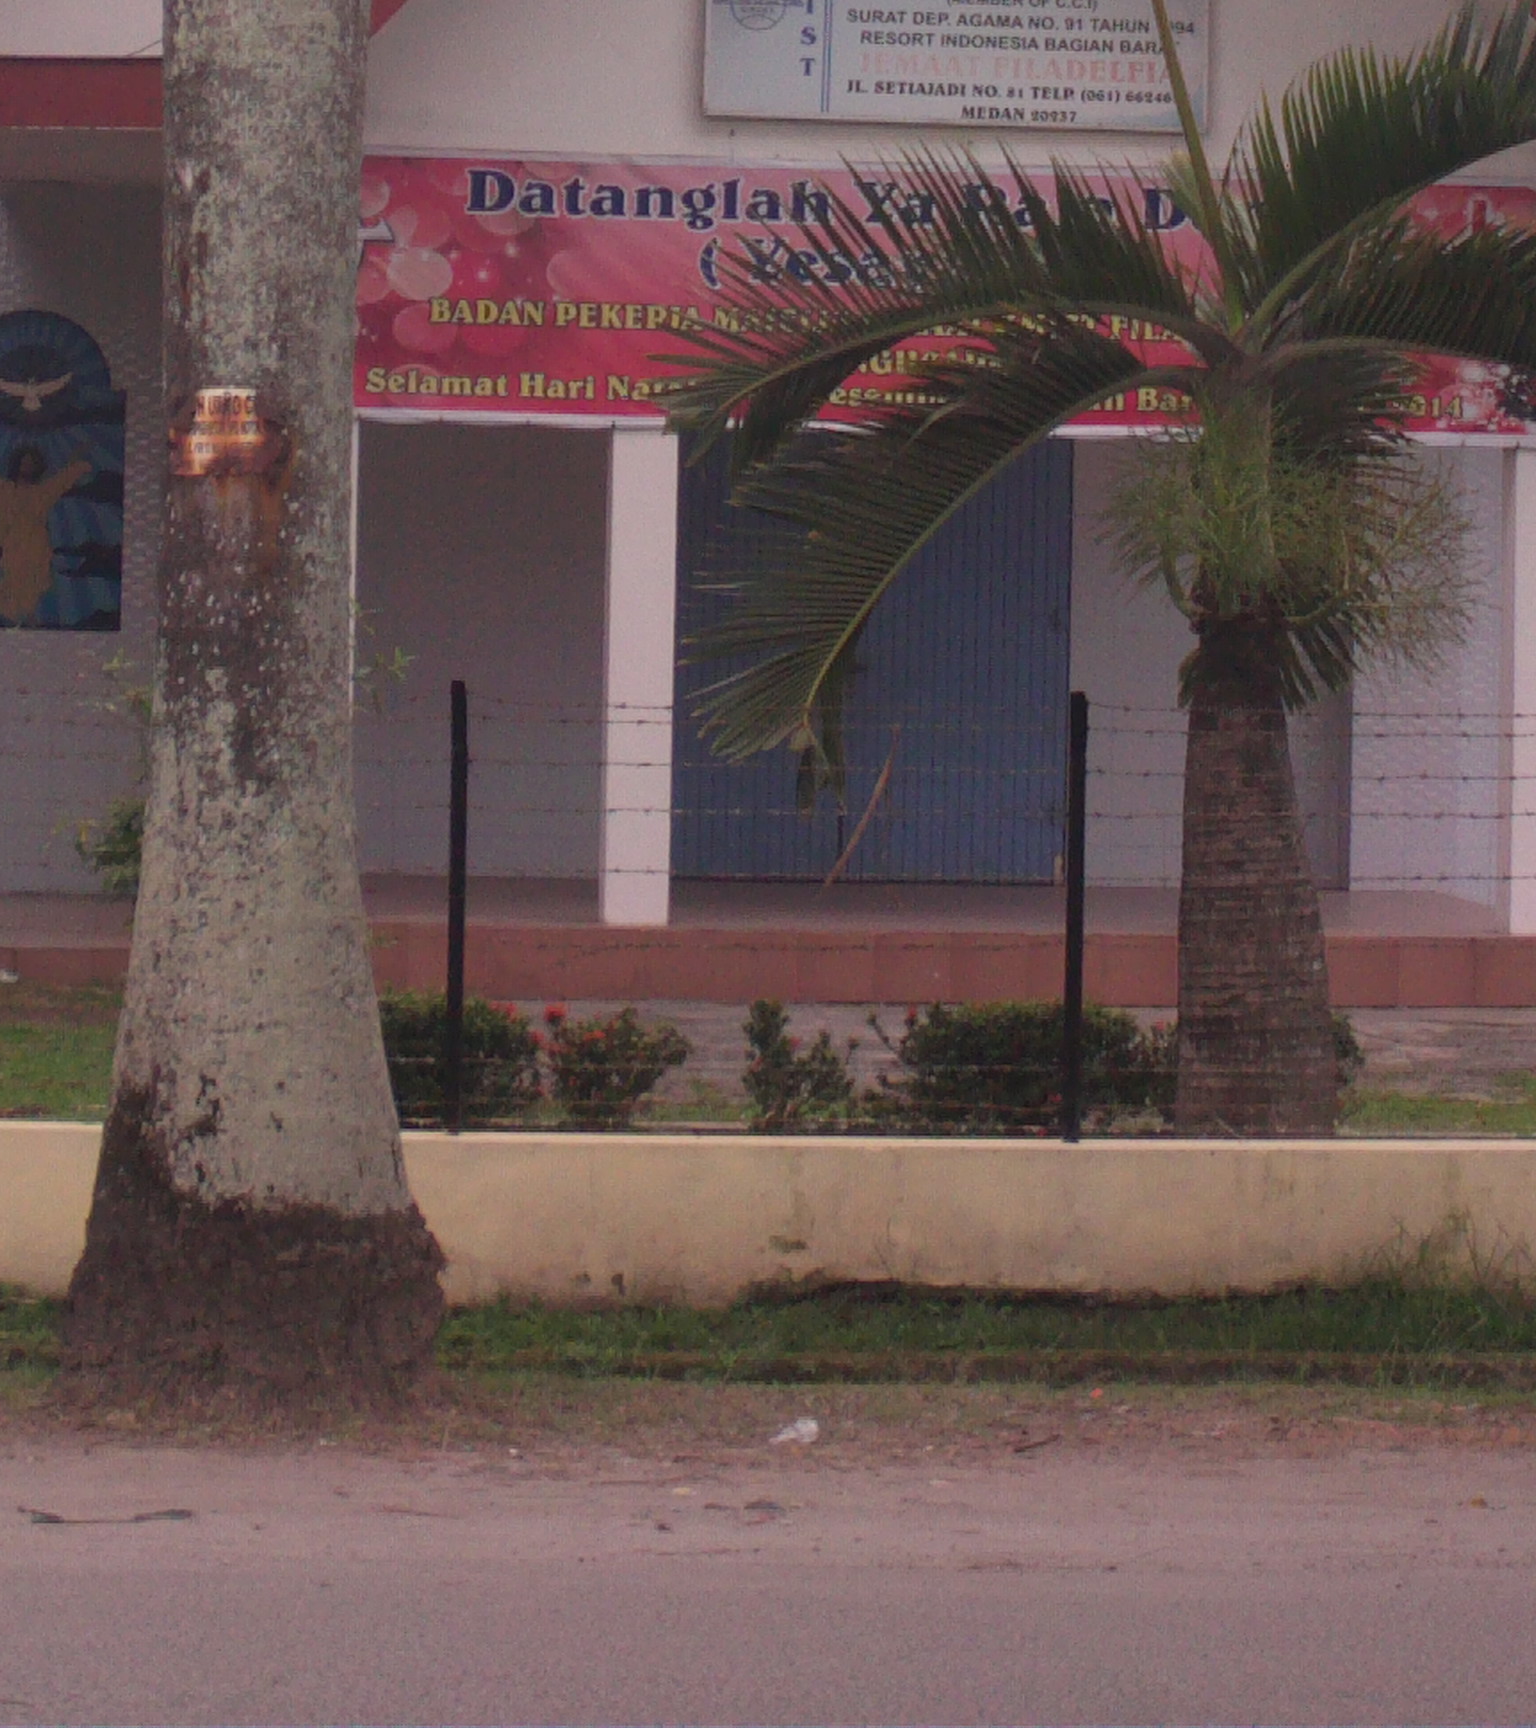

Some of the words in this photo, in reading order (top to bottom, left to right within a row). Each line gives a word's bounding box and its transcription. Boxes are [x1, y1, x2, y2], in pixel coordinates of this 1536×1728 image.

[846, 8, 908, 24] SURAT
[912, 11, 952, 26] DEP.
[956, 13, 1024, 29] AGAMA
[1028, 15, 1060, 31] NO.
[1089, 18, 1150, 34] TAHUN
[859, 29, 935, 47] RESORT
[940, 32, 1039, 51] INDONESIA
[1044, 37, 1114, 54] BAGIAN
[1119, 39, 1181, 55] BAR
[859, 52, 981, 77] JEMAAT
[874, 80, 967, 97] SETIAJADI
[972, 84, 1002, 99] NO.
[961, 105, 1025, 120] MEDAN
[465, 167, 833, 231] Datanglah
[429, 297, 545, 327] BADAN
[364, 367, 509, 397] Selamat
[518, 372, 595, 400] Hari
